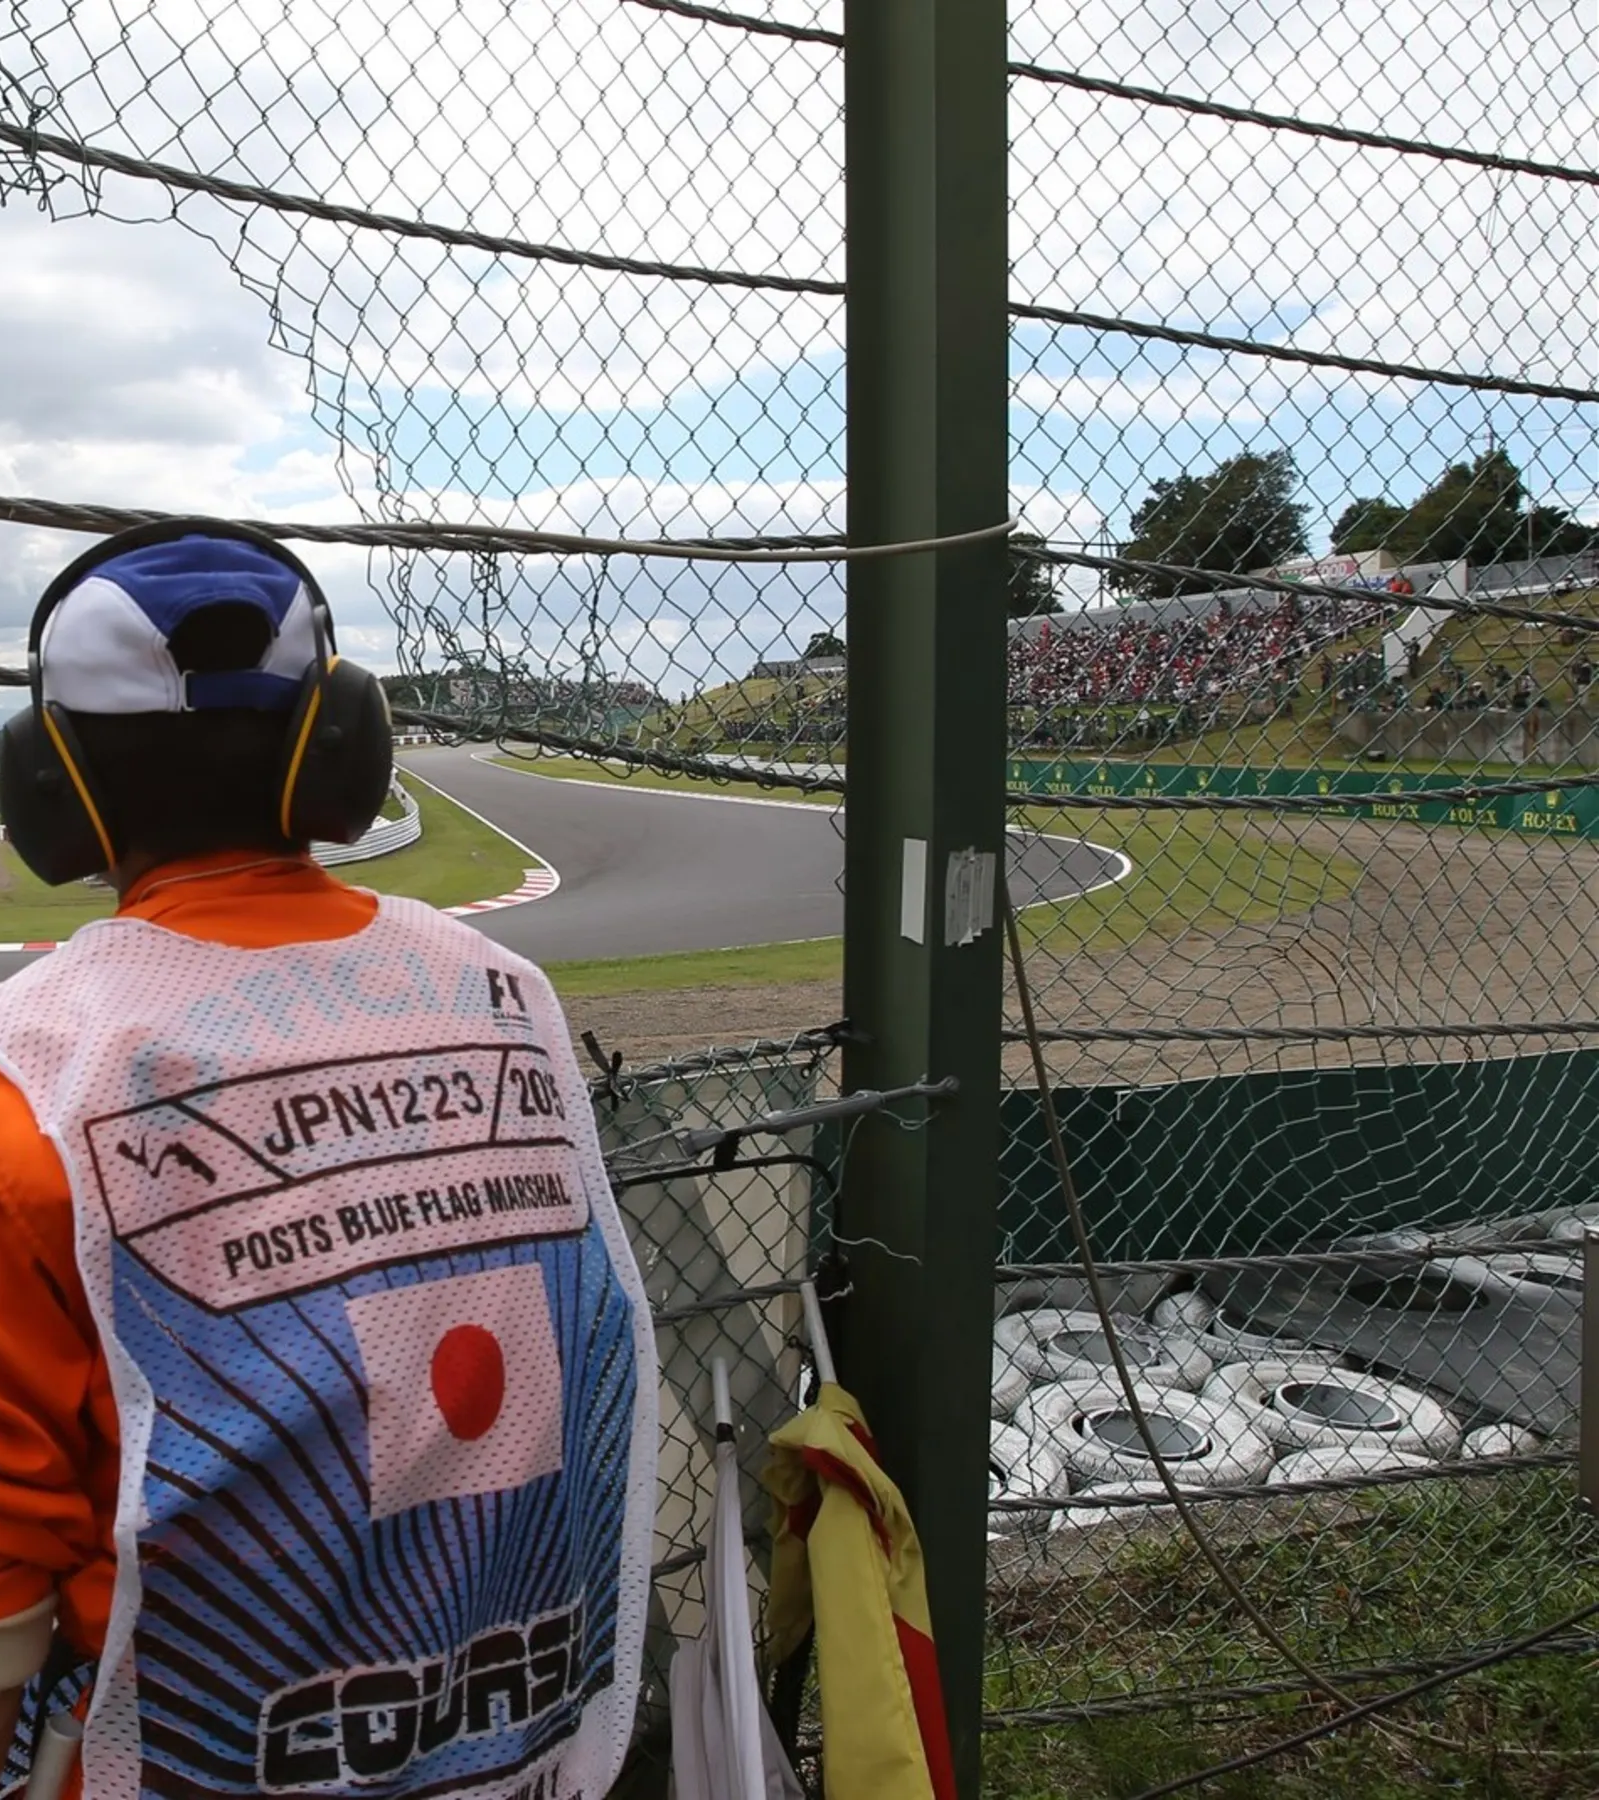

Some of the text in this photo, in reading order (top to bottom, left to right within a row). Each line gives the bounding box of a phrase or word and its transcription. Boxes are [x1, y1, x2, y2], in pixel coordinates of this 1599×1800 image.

[265, 1071, 484, 1156] JPN1223
[222, 1173, 572, 1278] POSTS BLUE FLAG MARSHAL
